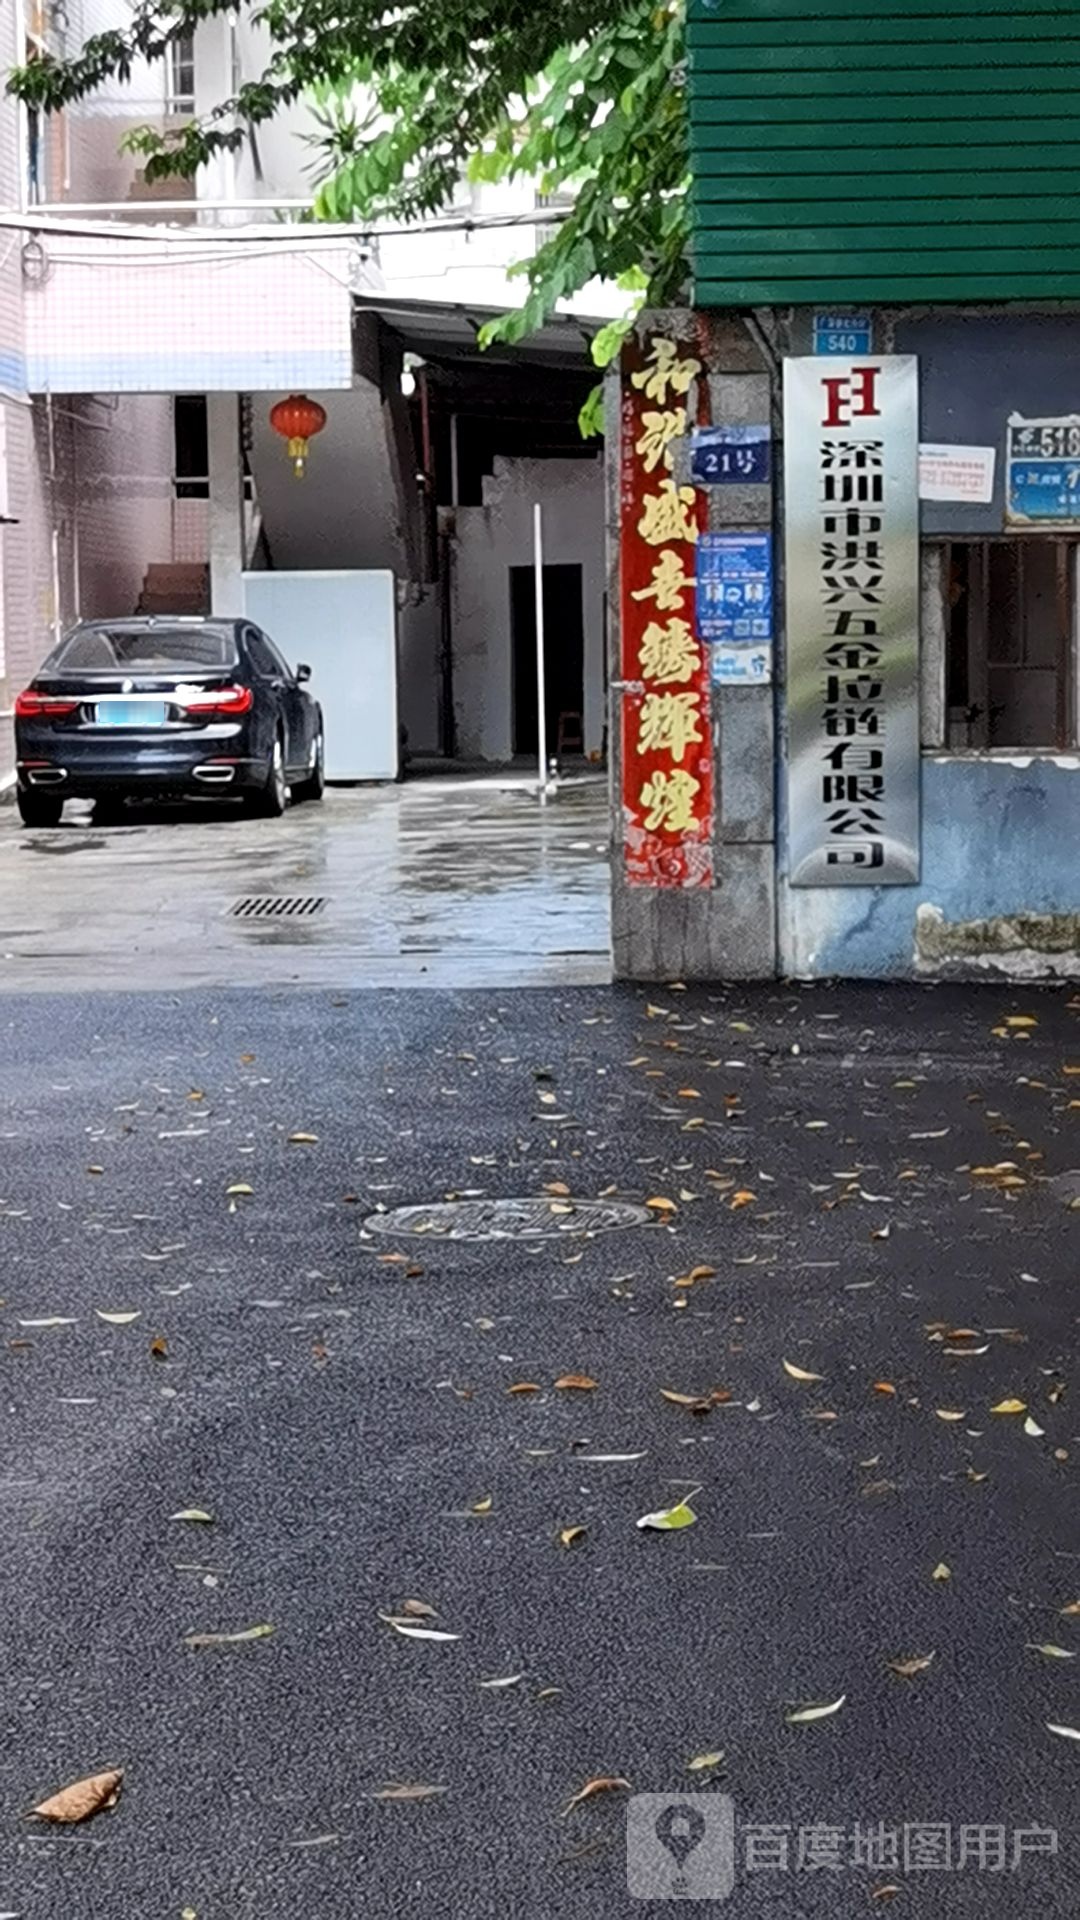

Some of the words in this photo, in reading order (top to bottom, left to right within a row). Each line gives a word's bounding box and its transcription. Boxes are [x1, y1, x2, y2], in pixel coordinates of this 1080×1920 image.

[705, 449, 757, 474] 21号
[820, 440, 885, 868] 深圳市洪兴五金拉链有限公司
